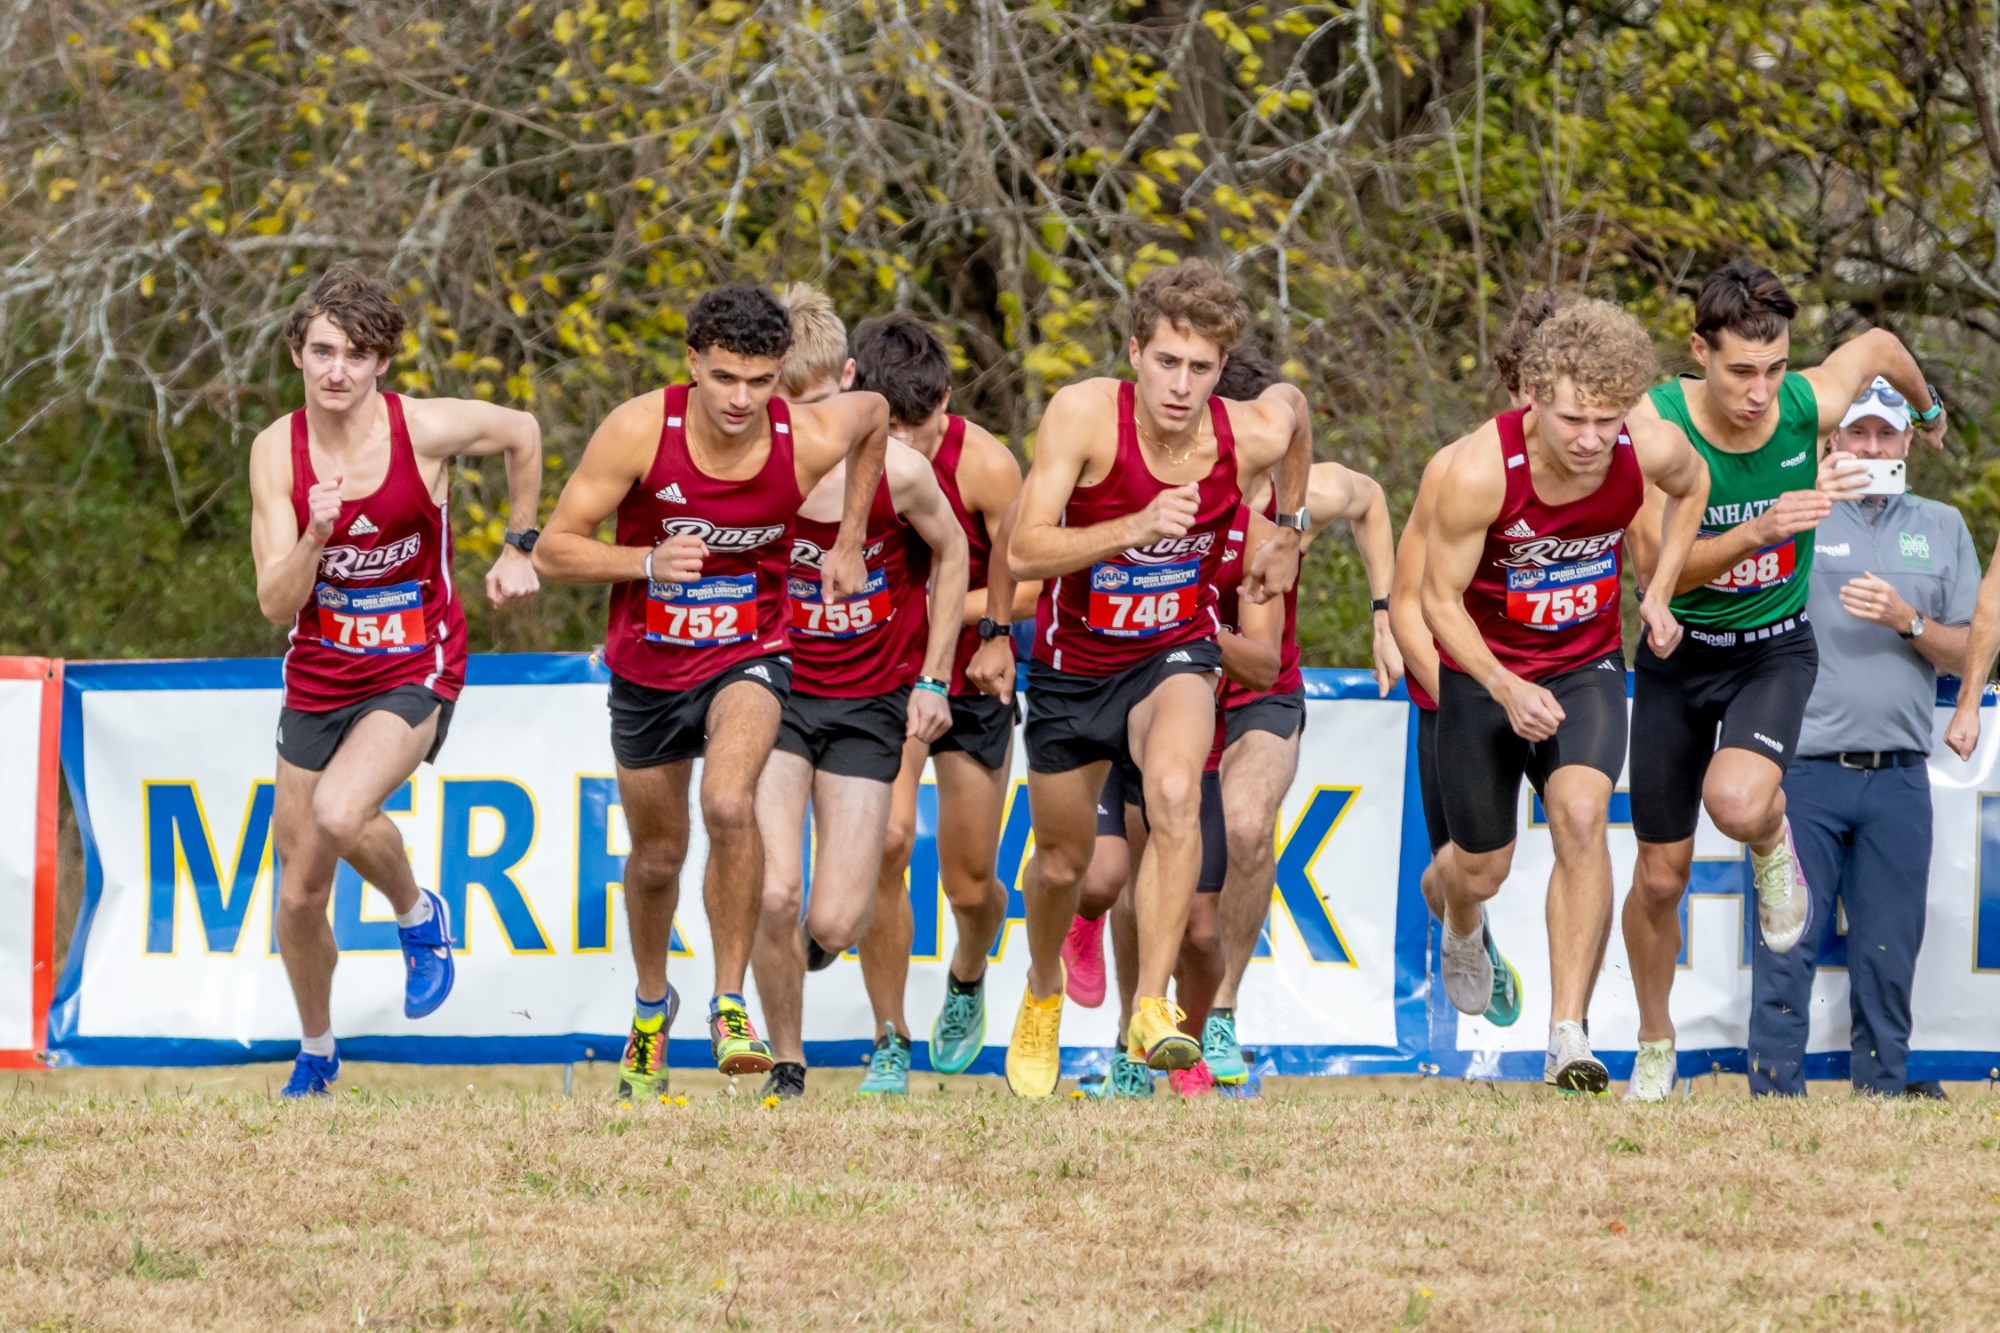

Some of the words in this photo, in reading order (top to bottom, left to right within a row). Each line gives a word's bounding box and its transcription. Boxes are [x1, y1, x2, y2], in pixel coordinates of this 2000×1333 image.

[1781, 451, 1806, 467] capelli
[655, 492, 687, 504] adidas
[348, 525, 379, 537] adidas
[662, 517, 785, 553] RIDER
[1504, 529, 1535, 538] adidas
[321, 533, 420, 580] RIDER
[790, 538, 884, 570] RIR
[1498, 529, 1624, 567] RIDER
[1577, 559, 1613, 573] COUNTRY
[1094, 570, 1129, 588] MAAC
[1133, 576, 1159, 586] CROSS
[1160, 569, 1196, 581] COUNTRY
[1510, 569, 1546, 587] MAAC
[318, 590, 348, 605] MAAC
[379, 591, 417, 603] COUNTRY
[651, 583, 683, 597] MAAC
[687, 587, 713, 598] CROSS
[714, 584, 754, 595] COUNTRY
[1108, 592, 1180, 628] 746
[1526, 584, 1597, 623] 753
[665, 605, 738, 638] 752
[801, 599, 873, 632] 755
[333, 613, 406, 648] 754
[1691, 629, 1736, 644] capelli
